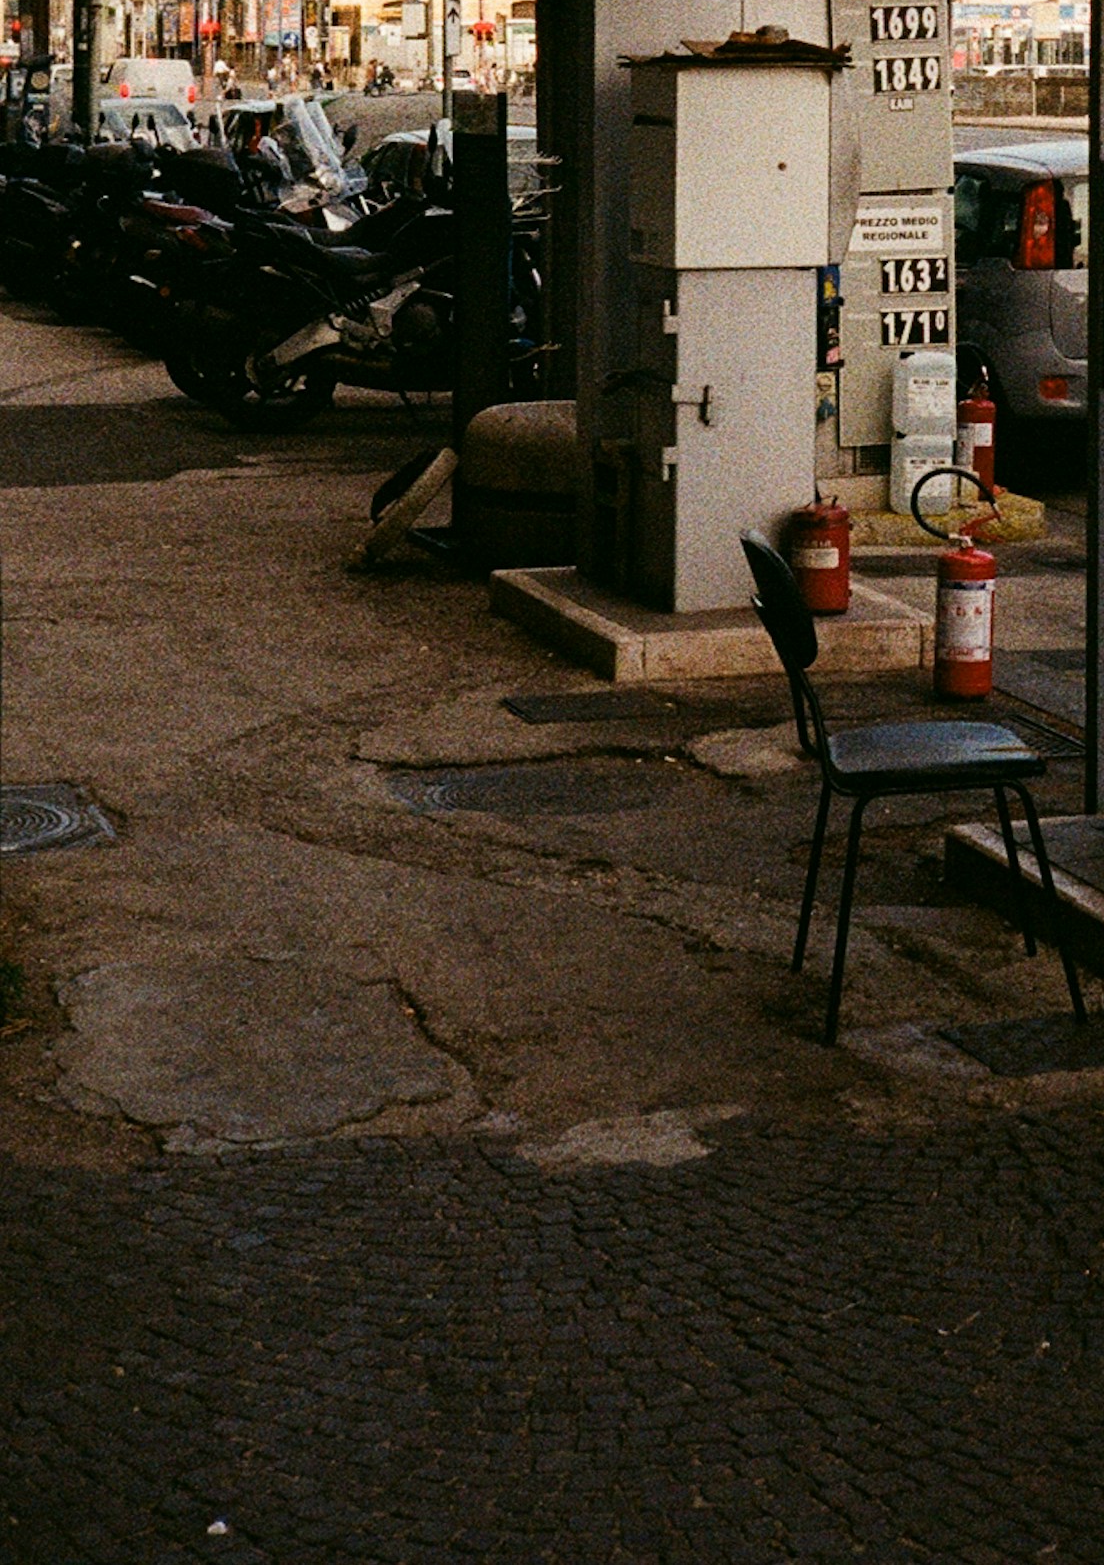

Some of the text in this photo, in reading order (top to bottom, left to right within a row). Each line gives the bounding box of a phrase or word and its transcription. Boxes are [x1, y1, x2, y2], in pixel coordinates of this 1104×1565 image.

[852, 215, 939, 227] PREZZO MEDIO
[862, 230, 929, 241] REGIONALE
